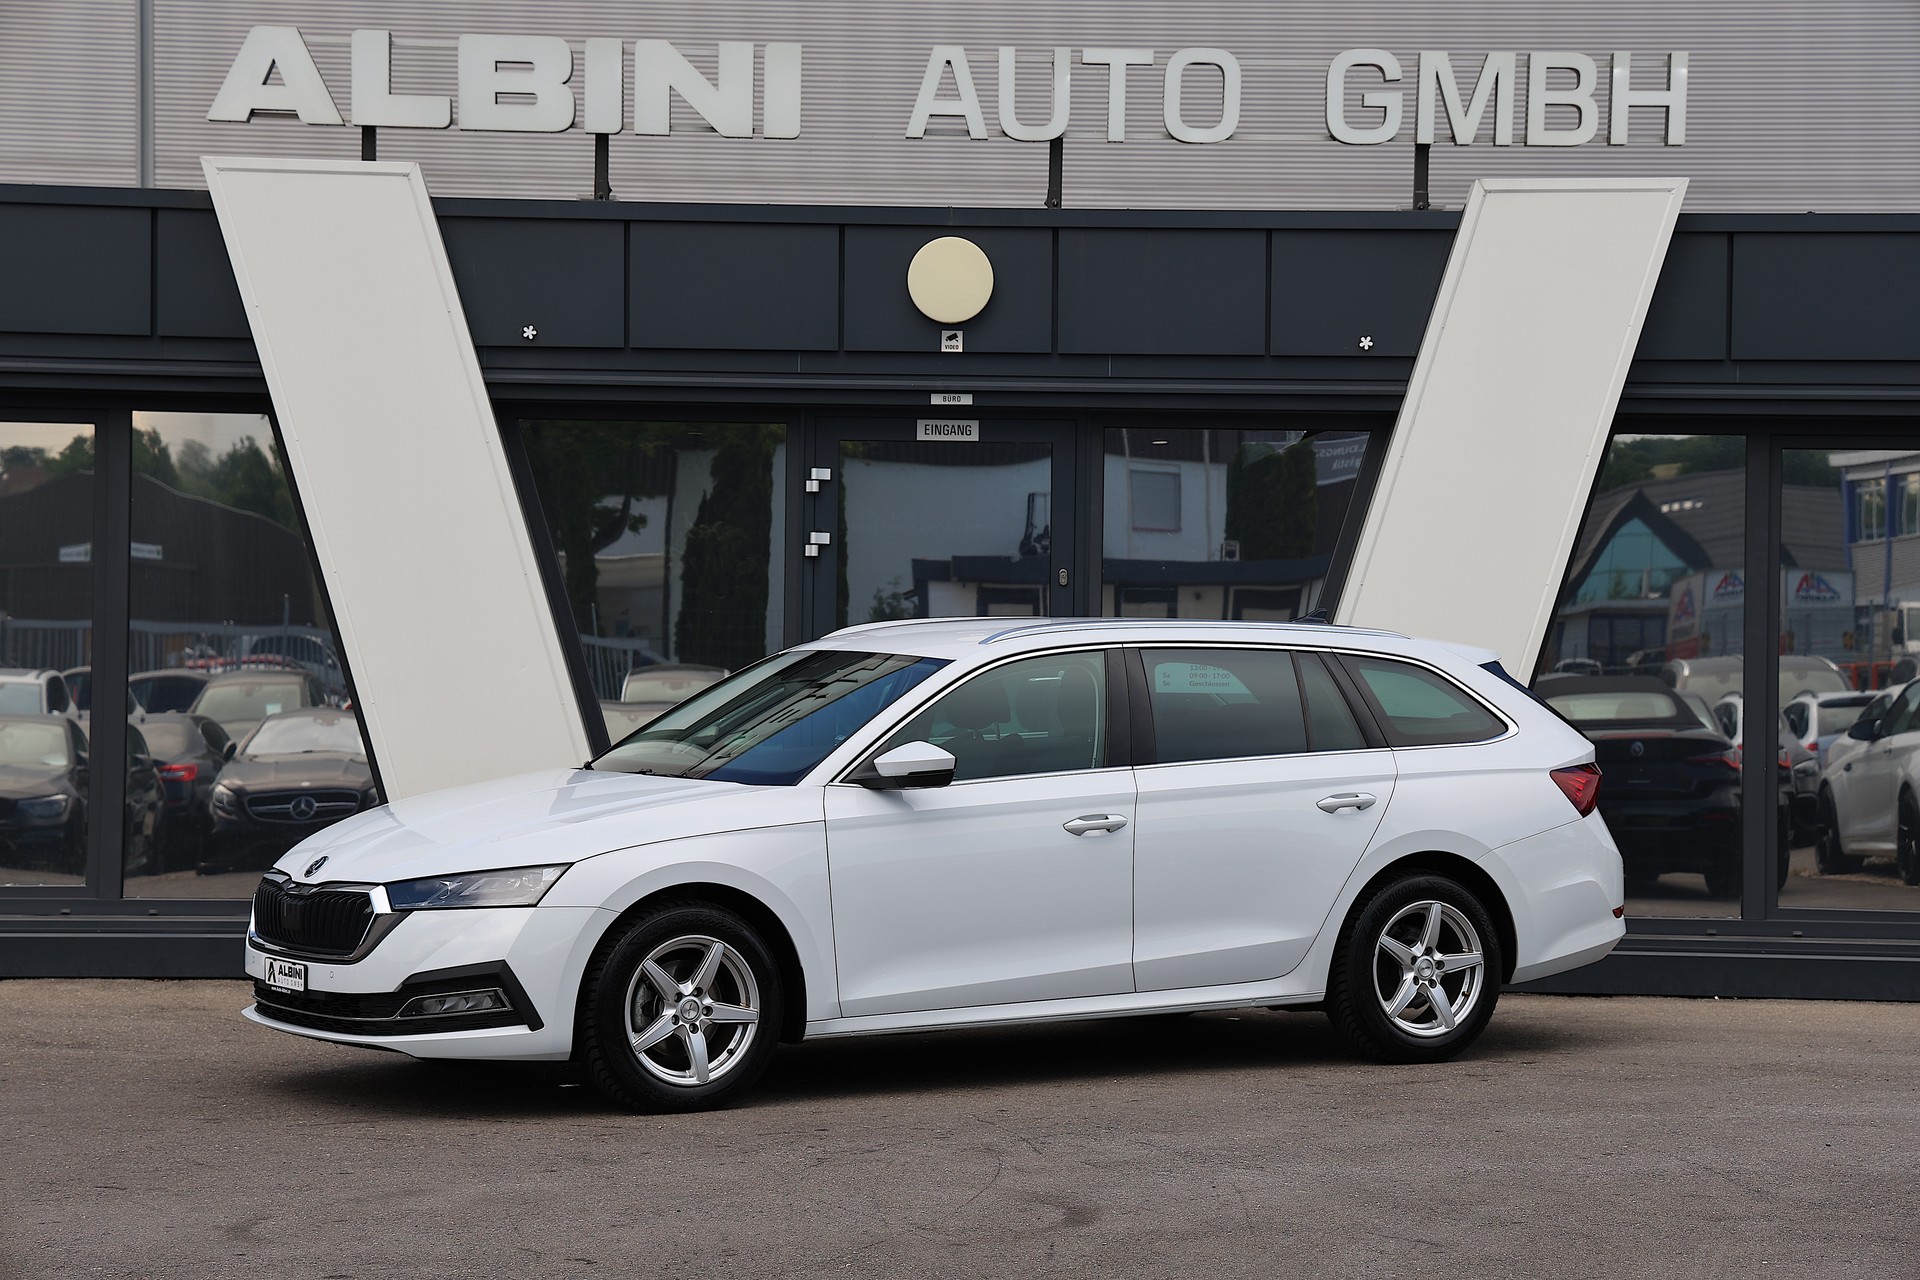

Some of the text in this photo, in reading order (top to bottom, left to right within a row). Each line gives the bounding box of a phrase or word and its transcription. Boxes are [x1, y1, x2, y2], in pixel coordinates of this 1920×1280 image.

[206, 25, 1689, 147] ALBINI AUTO GMBH
[942, 395, 962, 403] BÜRO
[924, 424, 972, 436] EINGANG
[278, 964, 303, 980] ALBINI
